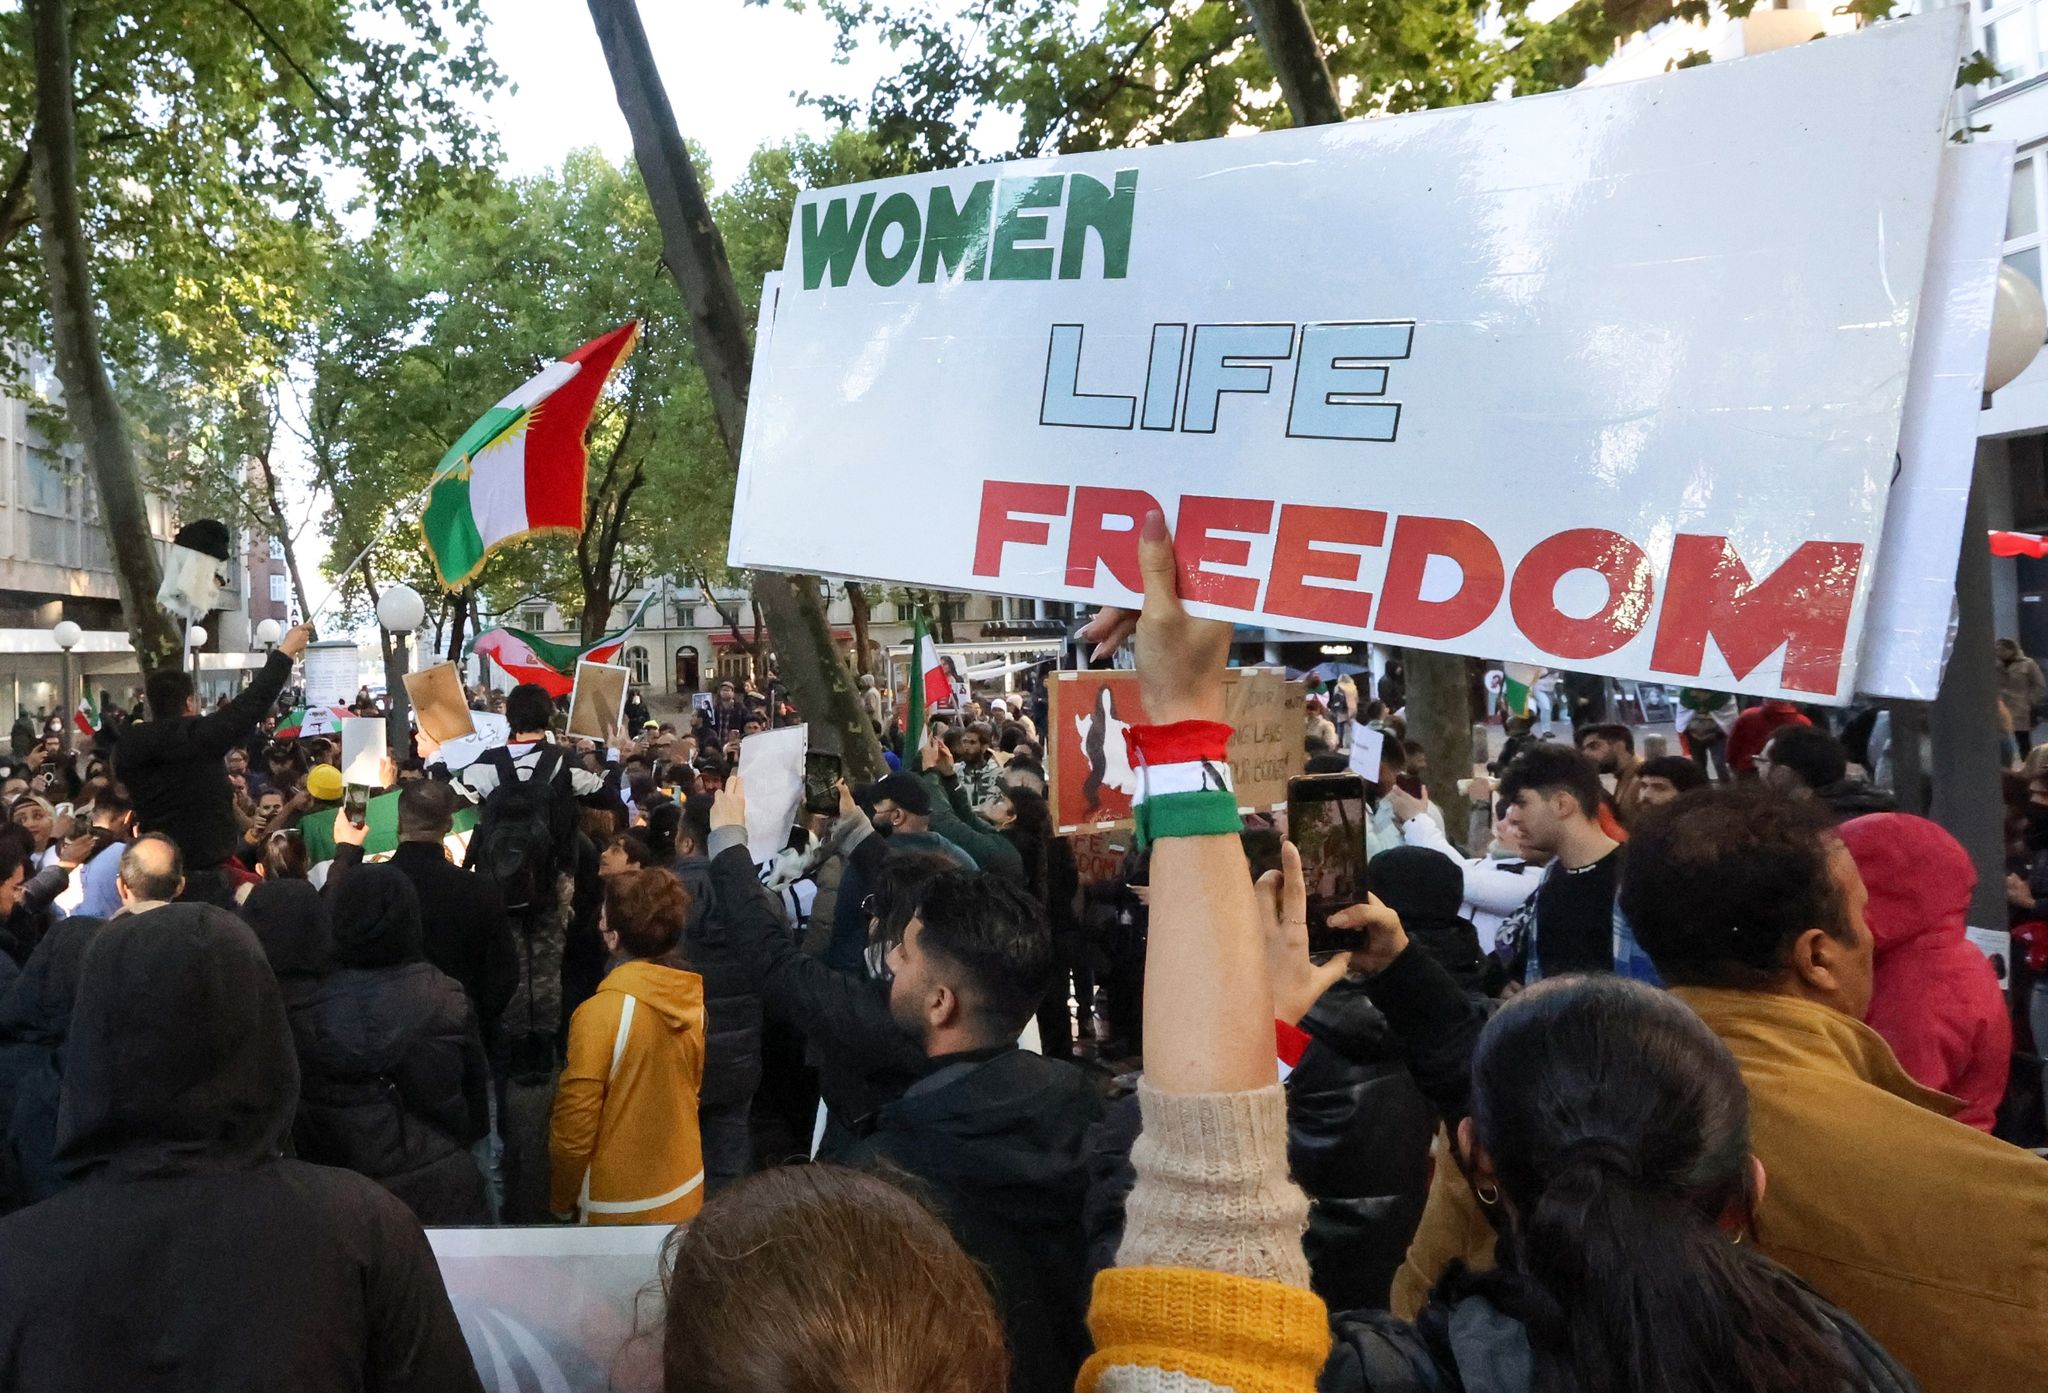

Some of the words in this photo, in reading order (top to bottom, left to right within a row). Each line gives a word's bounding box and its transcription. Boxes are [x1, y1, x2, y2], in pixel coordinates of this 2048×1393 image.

[801, 169, 1139, 290] WOMEN
[1040, 319, 1415, 442] LIFE
[973, 480, 1864, 695] FREEDOM
